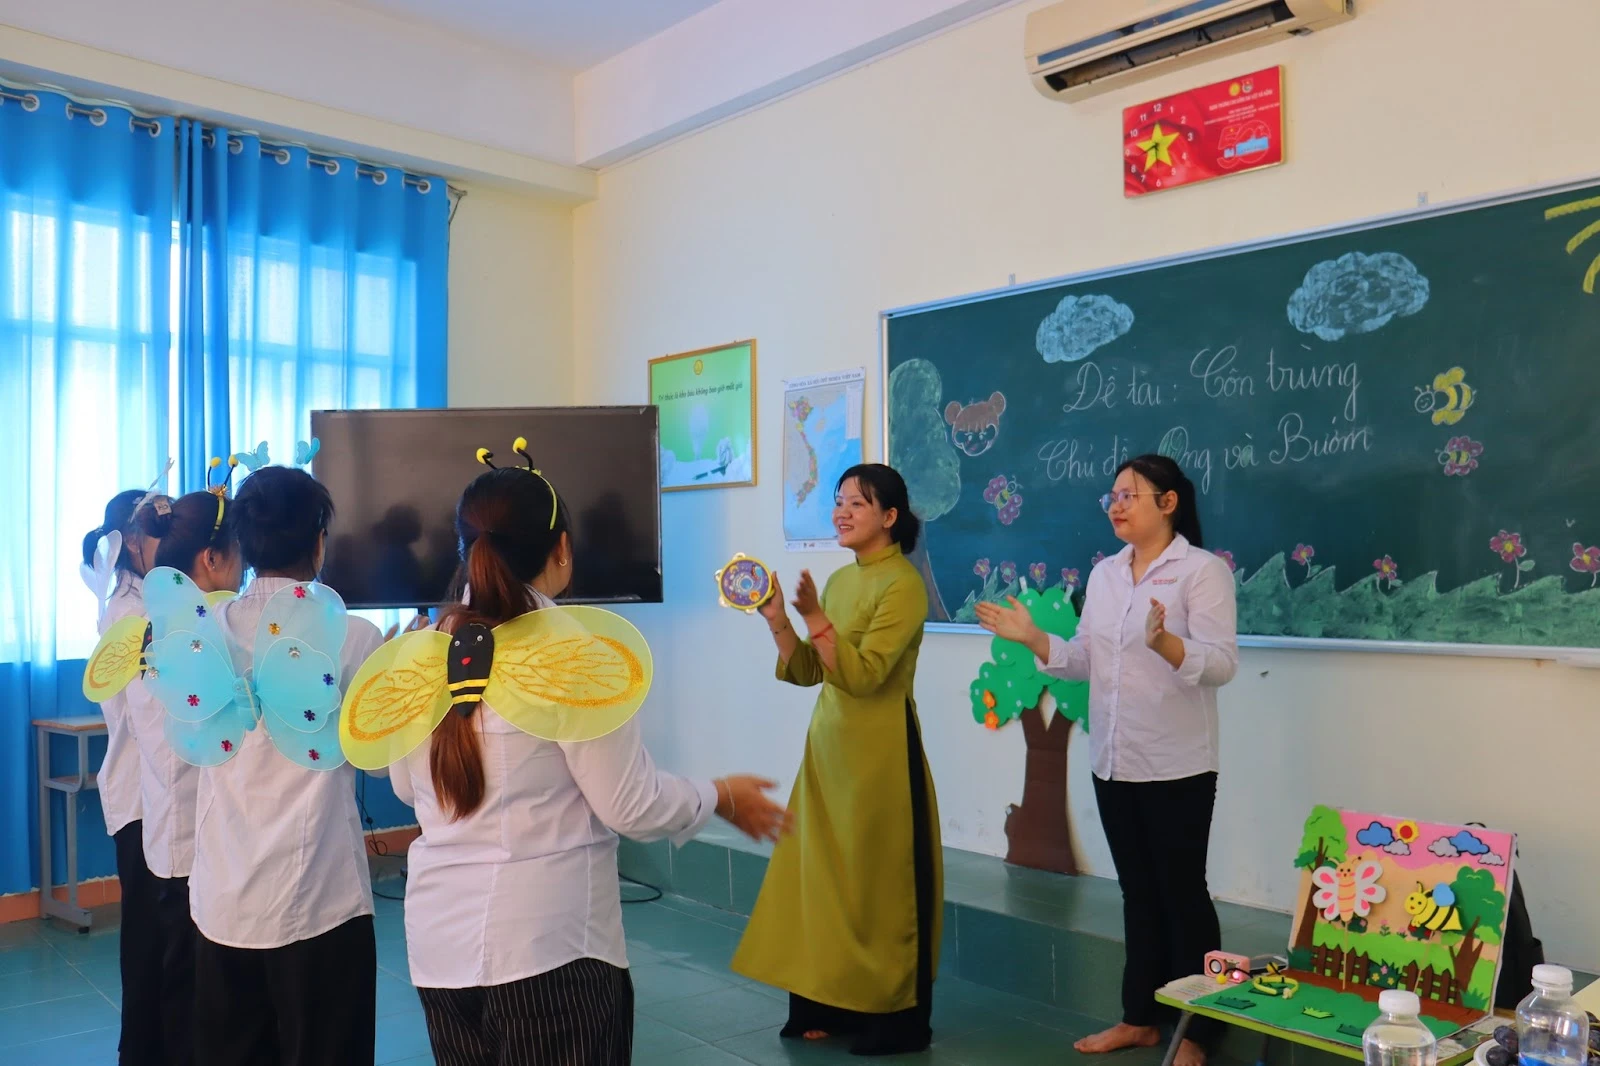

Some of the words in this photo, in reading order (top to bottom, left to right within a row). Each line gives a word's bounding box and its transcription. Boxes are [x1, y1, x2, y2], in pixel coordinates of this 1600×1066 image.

[1153, 103, 1162, 112] 12
[1170, 106, 1174, 114] 1
[1181, 116, 1187, 124] 2
[1130, 129, 1138, 138] 10
[1187, 132, 1193, 141] 3
[1182, 152, 1187, 160] 4
[1131, 165, 1136, 173] 8
[1171, 167, 1176, 176] 5
[1141, 175, 1146, 183] 7
[1156, 179, 1161, 187] 6
[1063, 362, 1117, 412] Đề
[1127, 366, 1161, 406] tài
[1190, 346, 1255, 398] Côn
[1266, 344, 1361, 421] trùng
[1038, 439, 1094, 481] Chủ
[1224, 433, 1259, 470] và
[1269, 413, 1373, 464] Bướm
